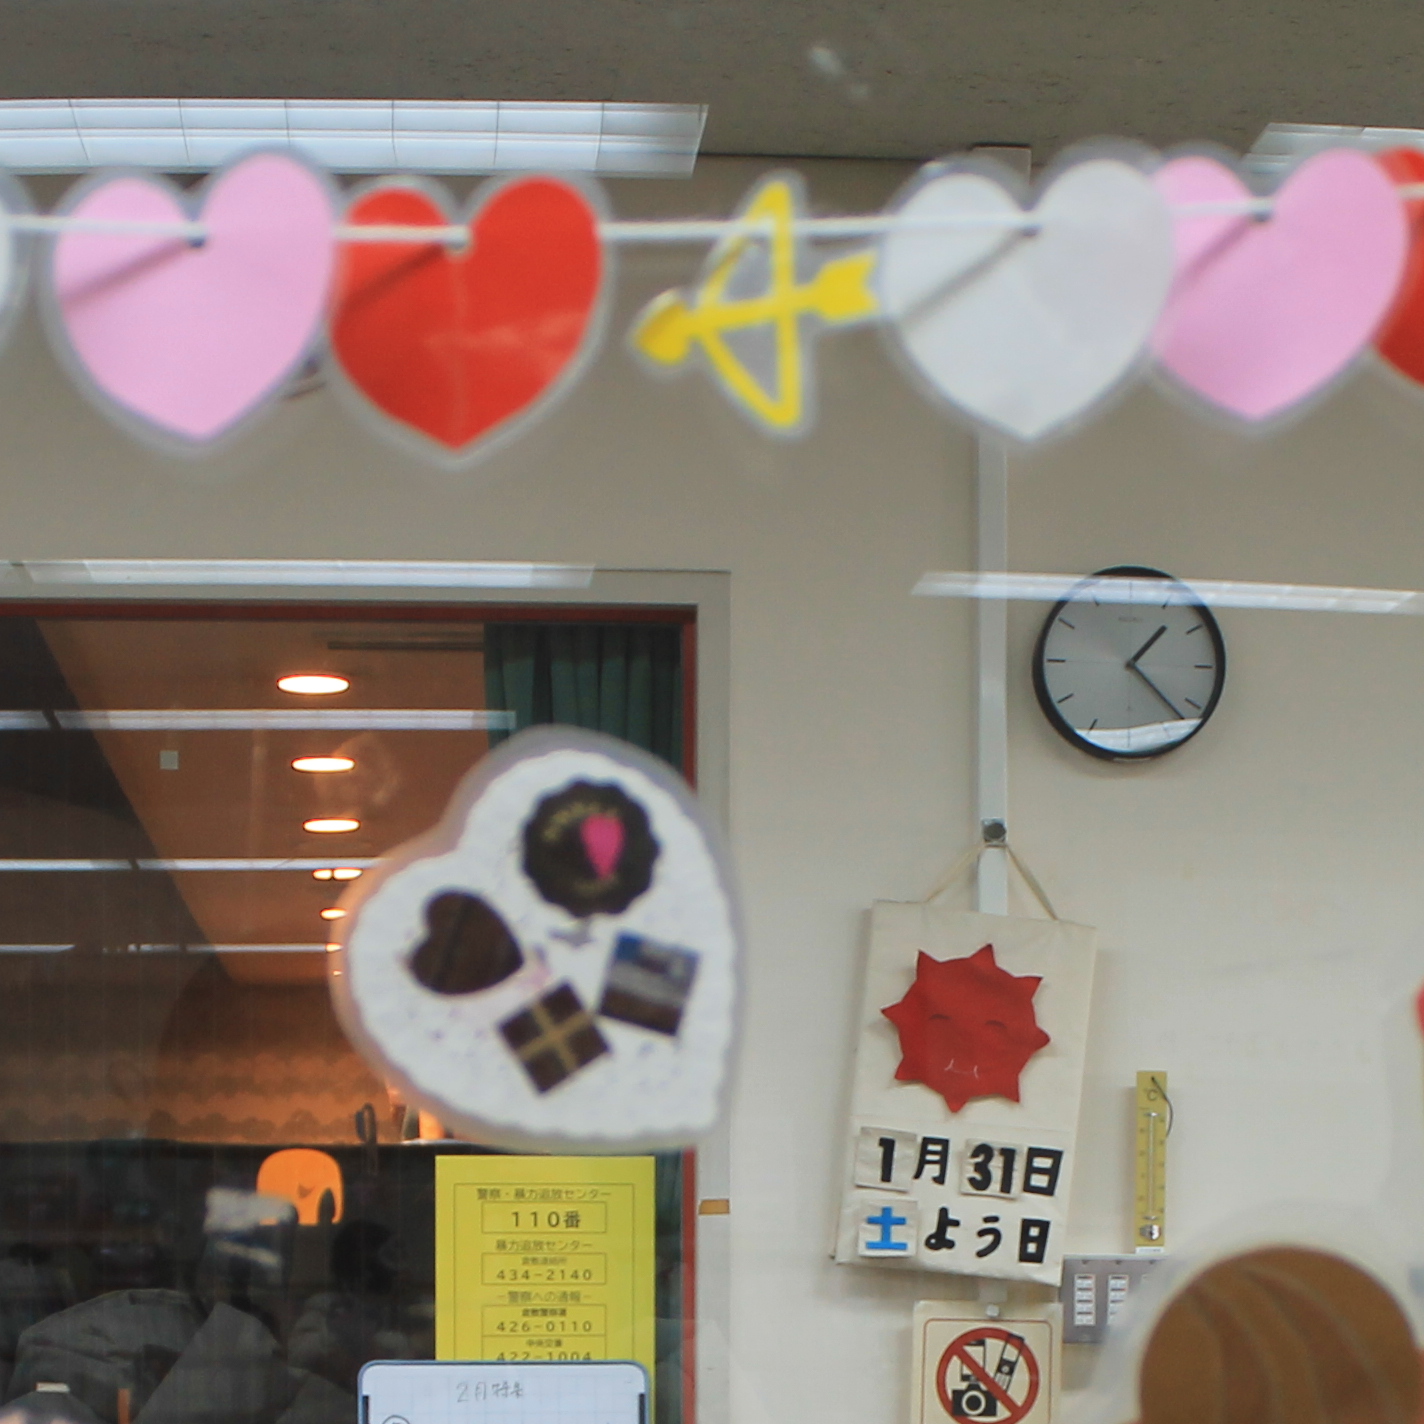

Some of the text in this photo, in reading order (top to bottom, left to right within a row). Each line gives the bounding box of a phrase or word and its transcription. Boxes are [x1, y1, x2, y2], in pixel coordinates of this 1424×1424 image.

[873, 1136, 1064, 1197] 1月31日
[512, 1210, 581, 1228] 110番
[866, 1206, 1051, 1264] 土よう日
